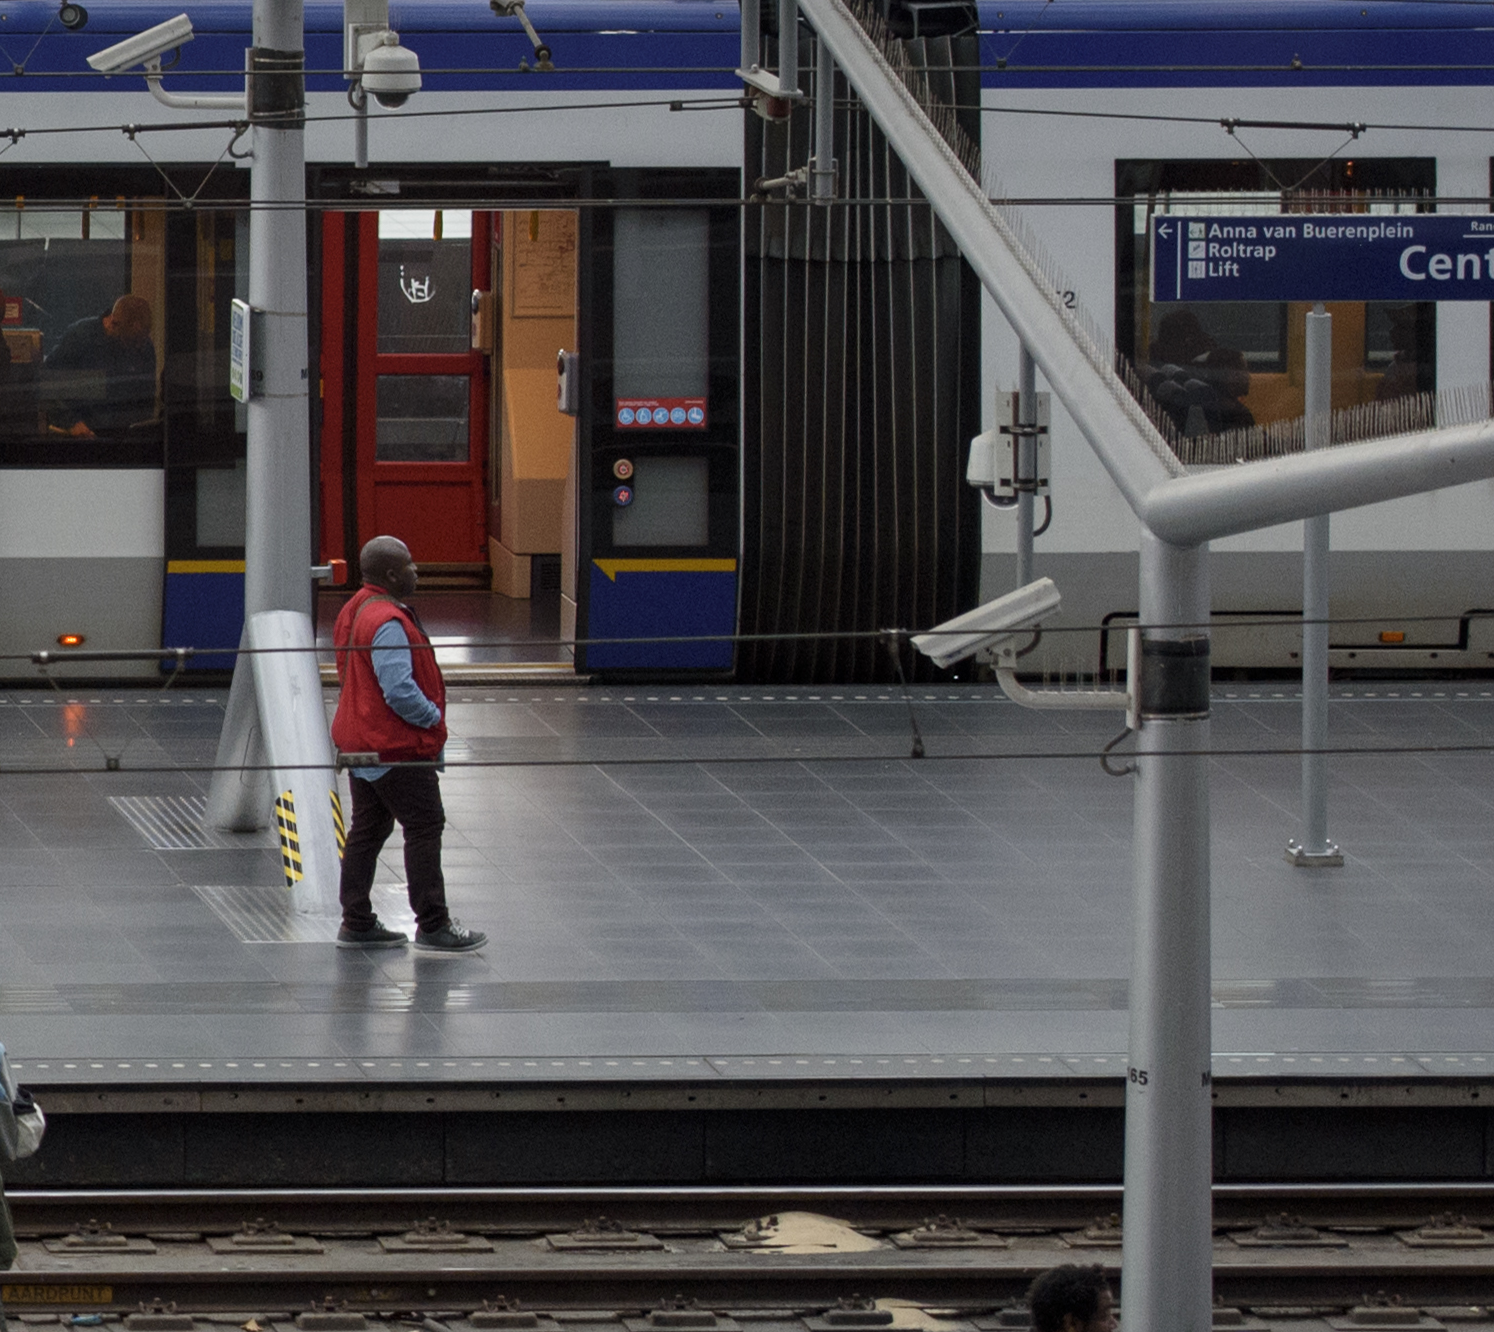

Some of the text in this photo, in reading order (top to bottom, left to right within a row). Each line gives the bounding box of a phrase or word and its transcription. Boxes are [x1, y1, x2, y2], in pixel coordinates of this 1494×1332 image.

[1208, 222, 1414, 245] Anna van Buerenplein
[1470, 221, 1494, 232] Ran
[1208, 241, 1277, 264] Roltrap
[1208, 261, 1241, 278] Lift
[1127, 1067, 1148, 1086] 65
